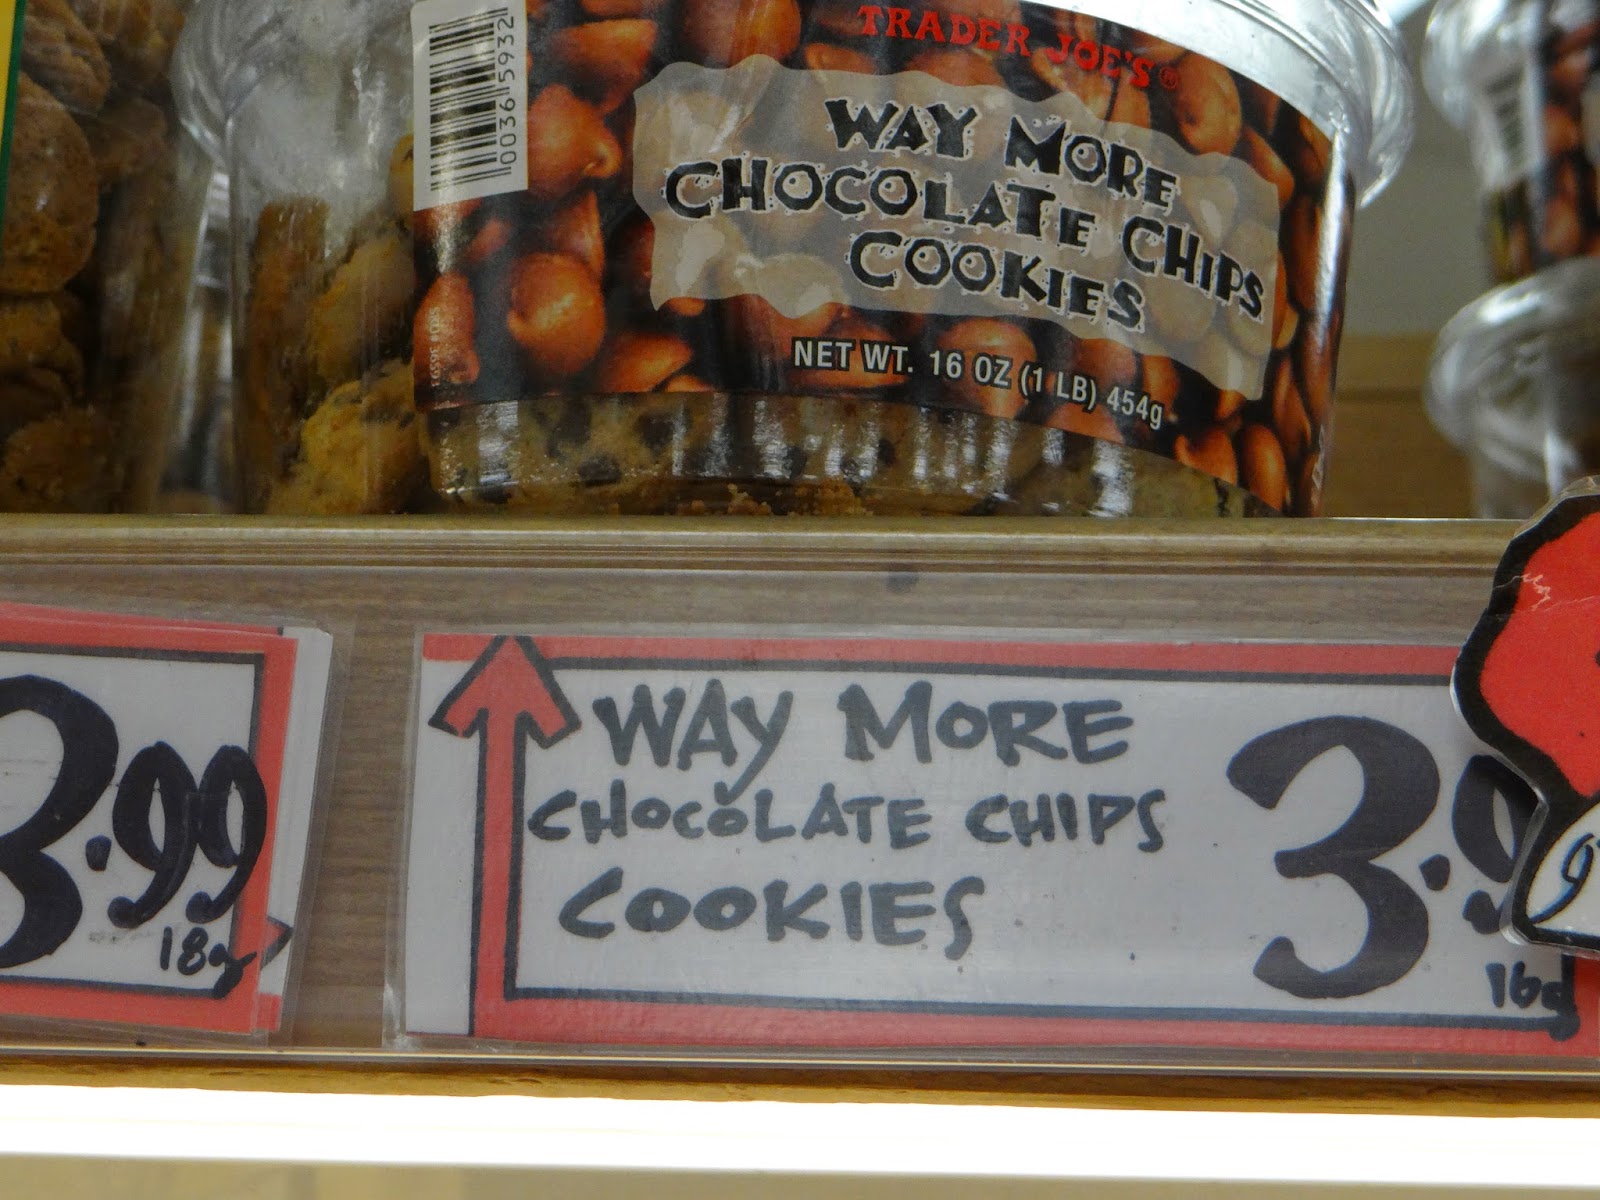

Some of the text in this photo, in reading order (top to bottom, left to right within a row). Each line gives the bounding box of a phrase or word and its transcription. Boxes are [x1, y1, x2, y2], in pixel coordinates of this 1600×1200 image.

[857, 5, 1031, 57] TRADER
[825, 96, 1181, 213] WAY MORE
[662, 156, 1266, 322] CHOCOLATE CHIPS
[847, 229, 1146, 332] COOKIES
[793, 340, 1164, 431] NET WT. 16 OZ (1 LB) 454g
[592, 678, 1134, 805] WAY MORE
[0, 674, 267, 969] 3.99
[526, 779, 1166, 853] CHOCOLATE CHIPS
[1225, 715, 1546, 999] 3.9
[558, 867, 986, 961] COOKIES
